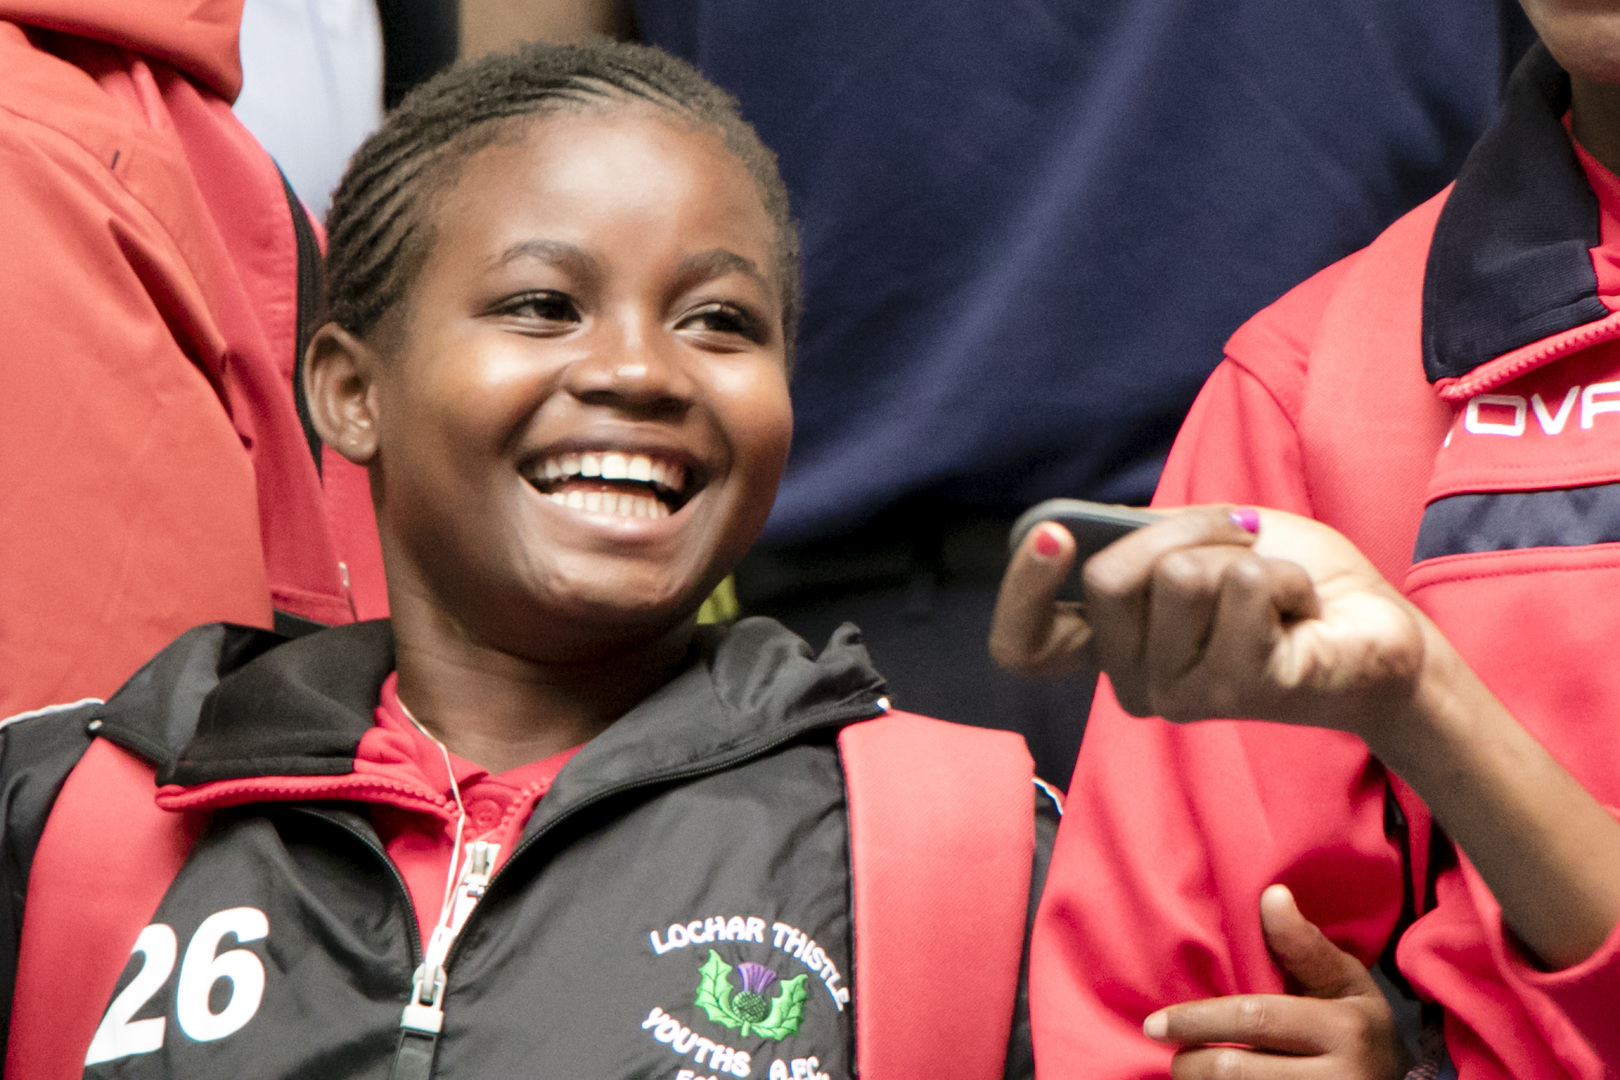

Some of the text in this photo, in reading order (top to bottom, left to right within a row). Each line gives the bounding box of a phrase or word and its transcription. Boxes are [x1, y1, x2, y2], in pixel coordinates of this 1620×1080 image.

[84, 906, 270, 1067] 26
[649, 915, 850, 1012] LOCHAR THISTLE
[641, 1006, 751, 1078] YOUTHS
